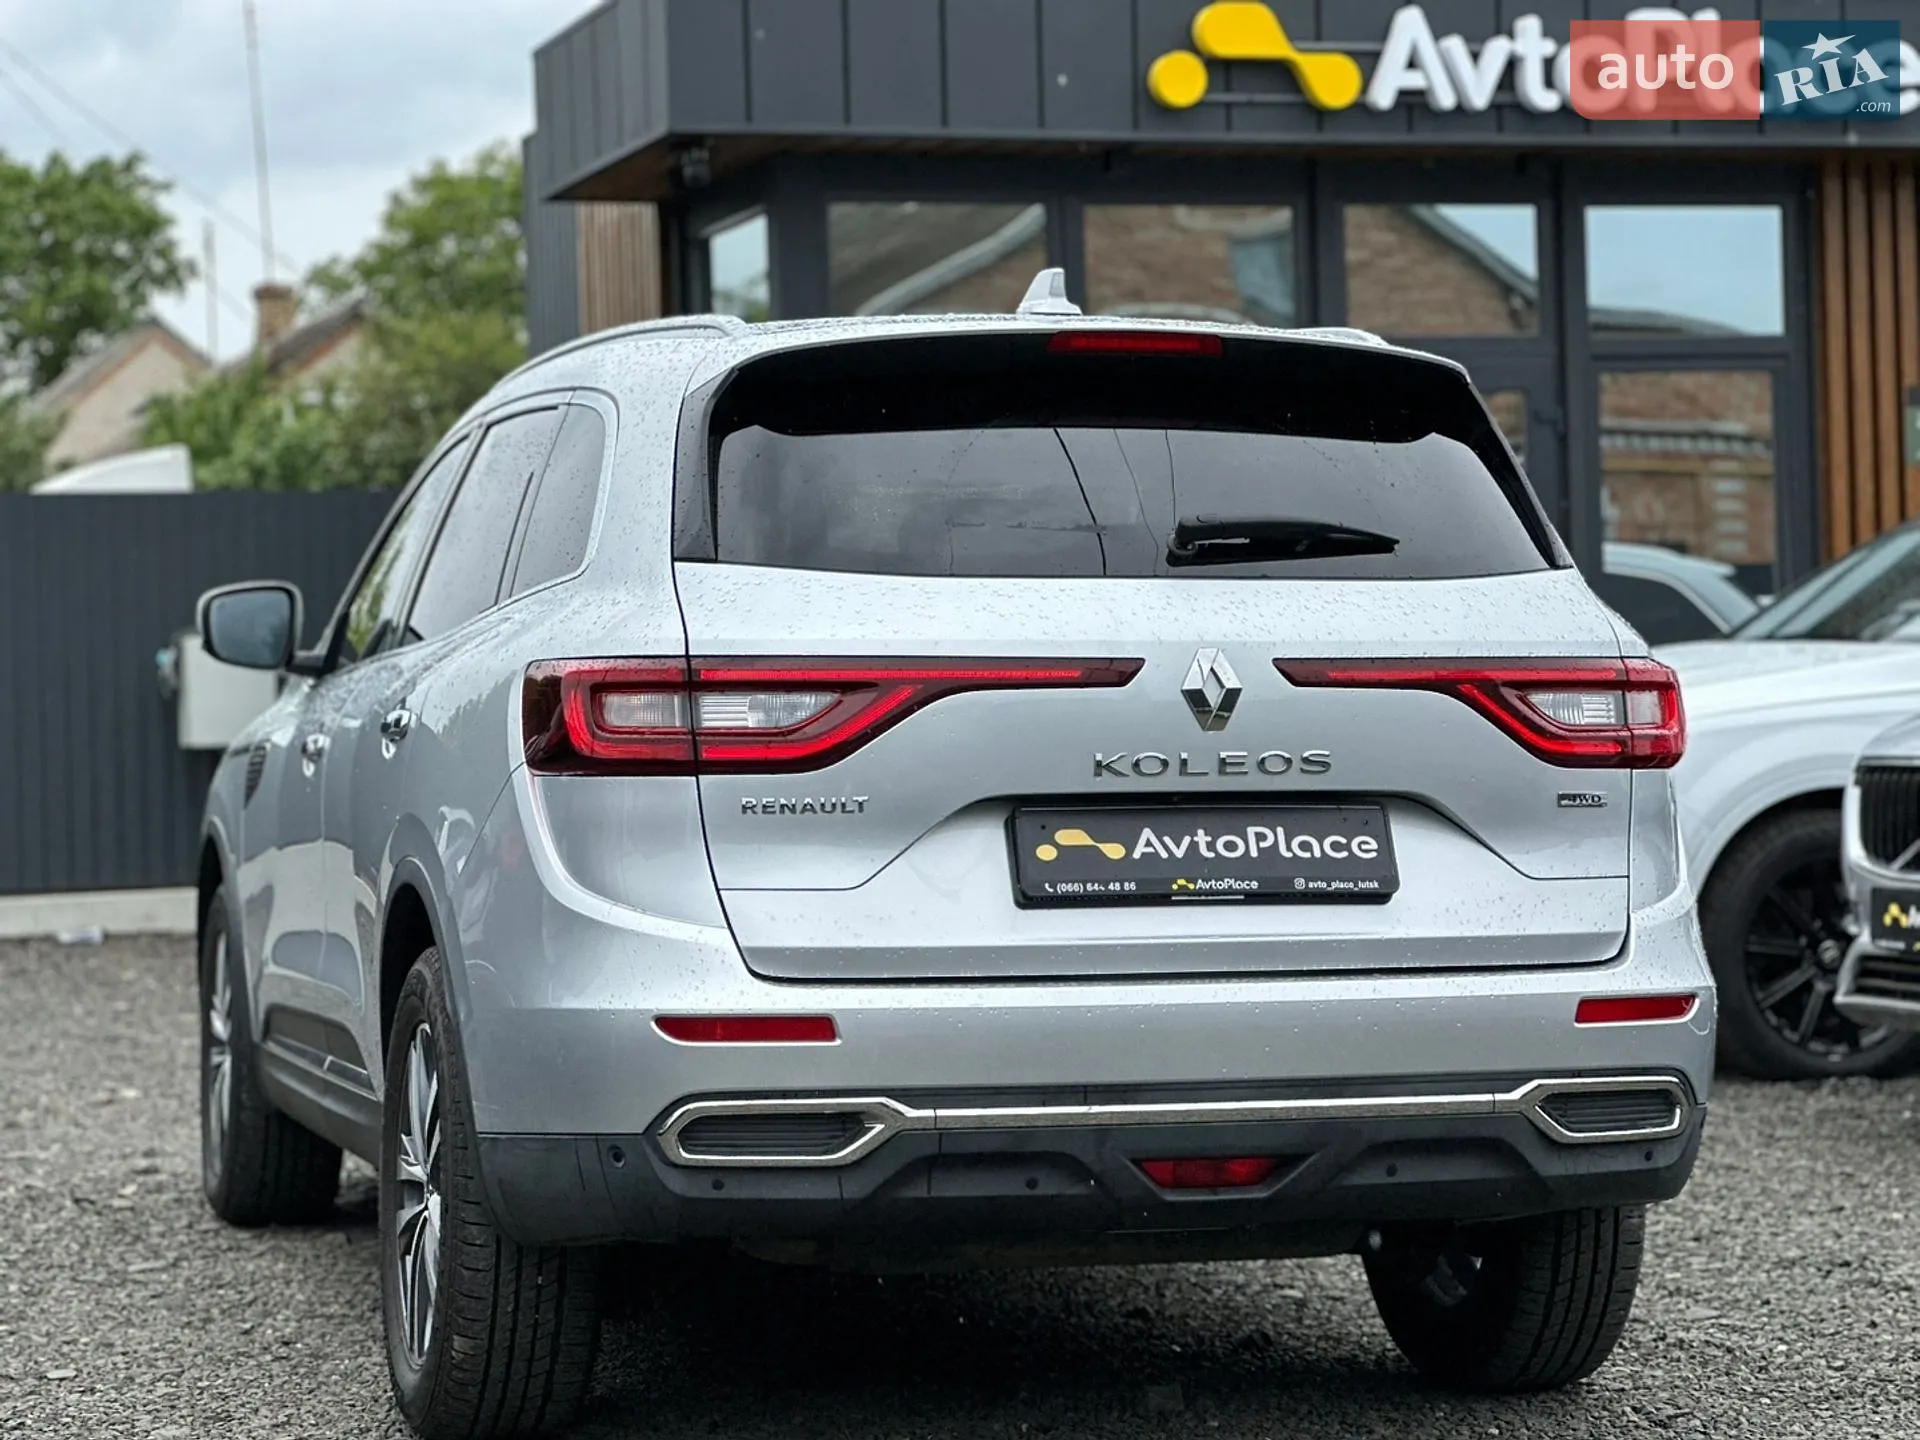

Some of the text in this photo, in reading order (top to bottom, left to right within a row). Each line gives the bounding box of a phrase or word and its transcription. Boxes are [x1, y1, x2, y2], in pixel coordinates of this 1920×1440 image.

[1093, 750, 1333, 778] KOLEOS
[740, 795, 869, 816] RENAULT
[1131, 826, 1380, 860] AvtoPlace
[1056, 881, 1084, 895] (066)
[1107, 881, 1121, 892] 48
[1195, 877, 1260, 890] AvtoPlace
